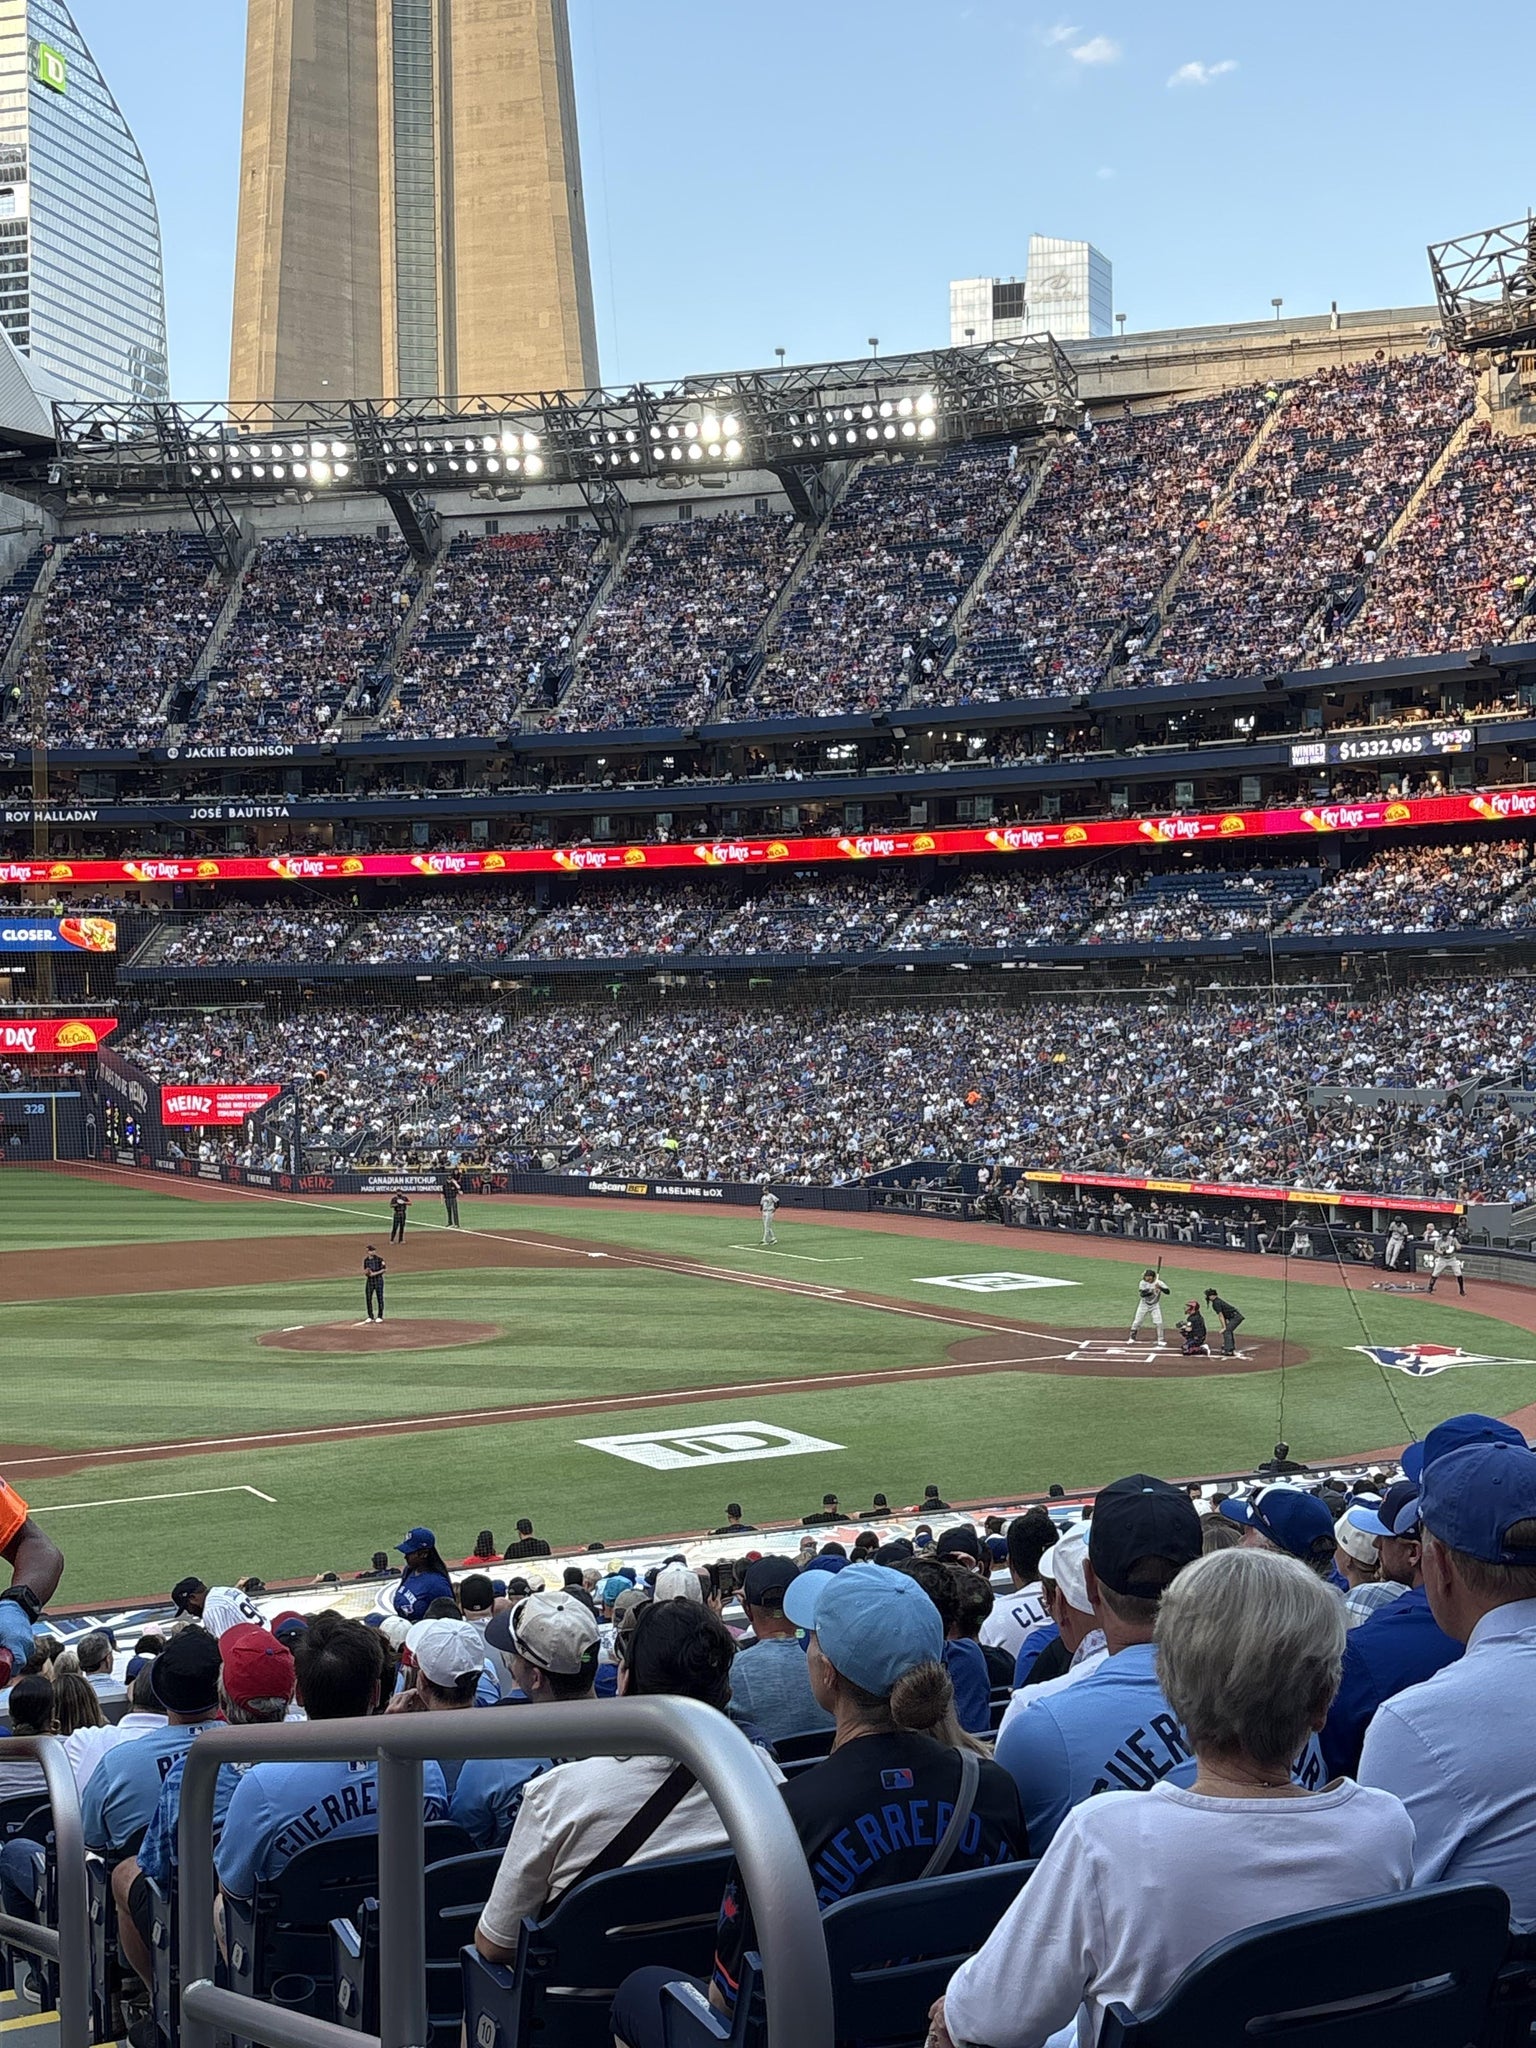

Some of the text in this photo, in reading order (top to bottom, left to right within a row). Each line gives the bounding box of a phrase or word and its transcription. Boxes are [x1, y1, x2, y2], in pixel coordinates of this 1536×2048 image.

[44, 53, 64, 84] TD
[185, 747, 226, 758] JACKIE
[230, 745, 294, 757] ROBINSON
[1291, 743, 1326, 758] WINNER
[1340, 736, 1422, 761] $1,332,965
[6, 810, 98, 822] ROY HALLADAY
[190, 806, 290, 819] JOSÉ BAUTISTA
[2, 929, 57, 941] CLOSER.
[6, 1027, 37, 1052] DAY
[24, 1104, 45, 1114] 328
[166, 1095, 212, 1114] HEINZ
[299, 1176, 335, 1190] HEINZ
[368, 1176, 403, 1185] CANADIAN
[588, 1181, 723, 1198] theScore BET BASELINE BOX
[613, 1431, 792, 1458] TD
[481, 2021, 492, 2044] 10
